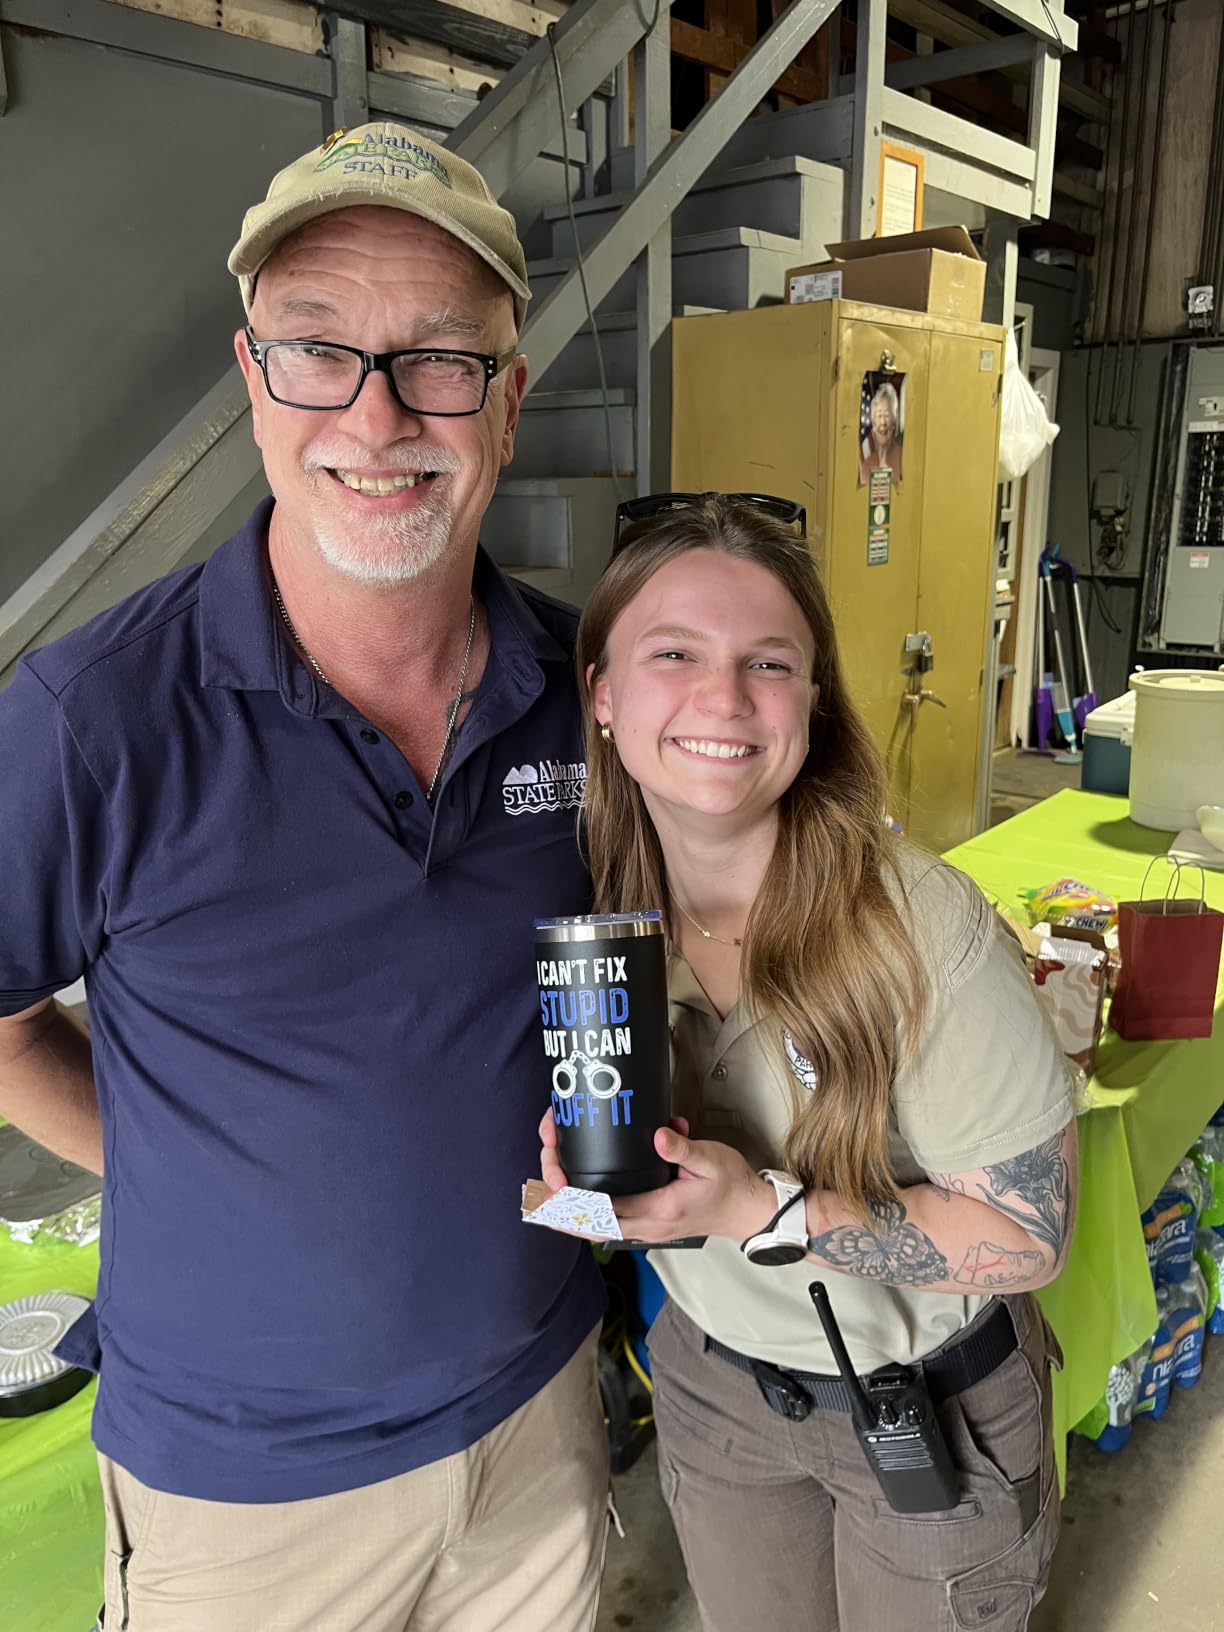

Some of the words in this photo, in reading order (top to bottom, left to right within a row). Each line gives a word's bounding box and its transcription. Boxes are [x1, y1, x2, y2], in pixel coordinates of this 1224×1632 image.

[343, 161, 417, 179] STAFF
[539, 760, 587, 783] Alabama
[502, 783, 557, 806] STATE
[536, 960, 542, 985] I
[540, 958, 588, 986] CAN'T
[593, 956, 628, 984] FIX
[539, 987, 630, 1027] STUPID
[543, 1029, 567, 1058] BUT
[571, 1030, 578, 1051] I
[584, 1027, 632, 1058] CAN
[551, 1089, 600, 1127] CUFF
[610, 1089, 634, 1126] IT
